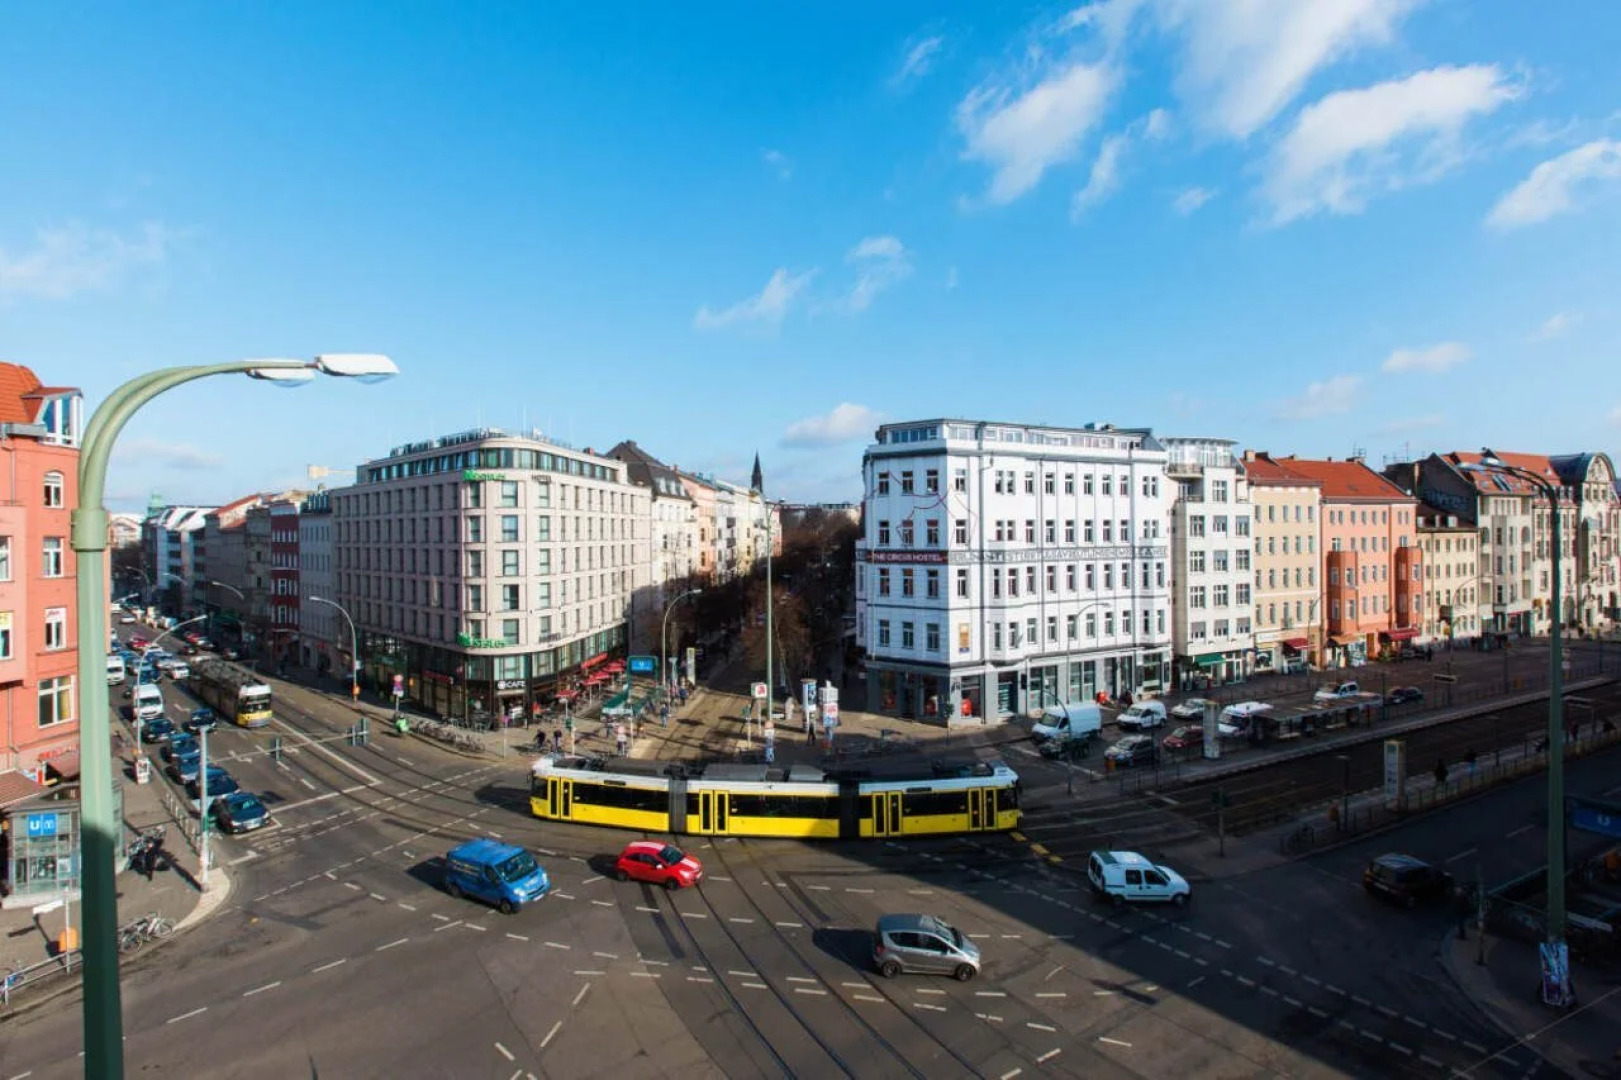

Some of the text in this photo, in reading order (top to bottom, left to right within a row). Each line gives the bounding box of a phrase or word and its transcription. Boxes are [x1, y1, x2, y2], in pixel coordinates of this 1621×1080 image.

[913, 552, 942, 562] HOSTEL
[1598, 814, 1610, 826] U
[30, 821, 40, 830] U
